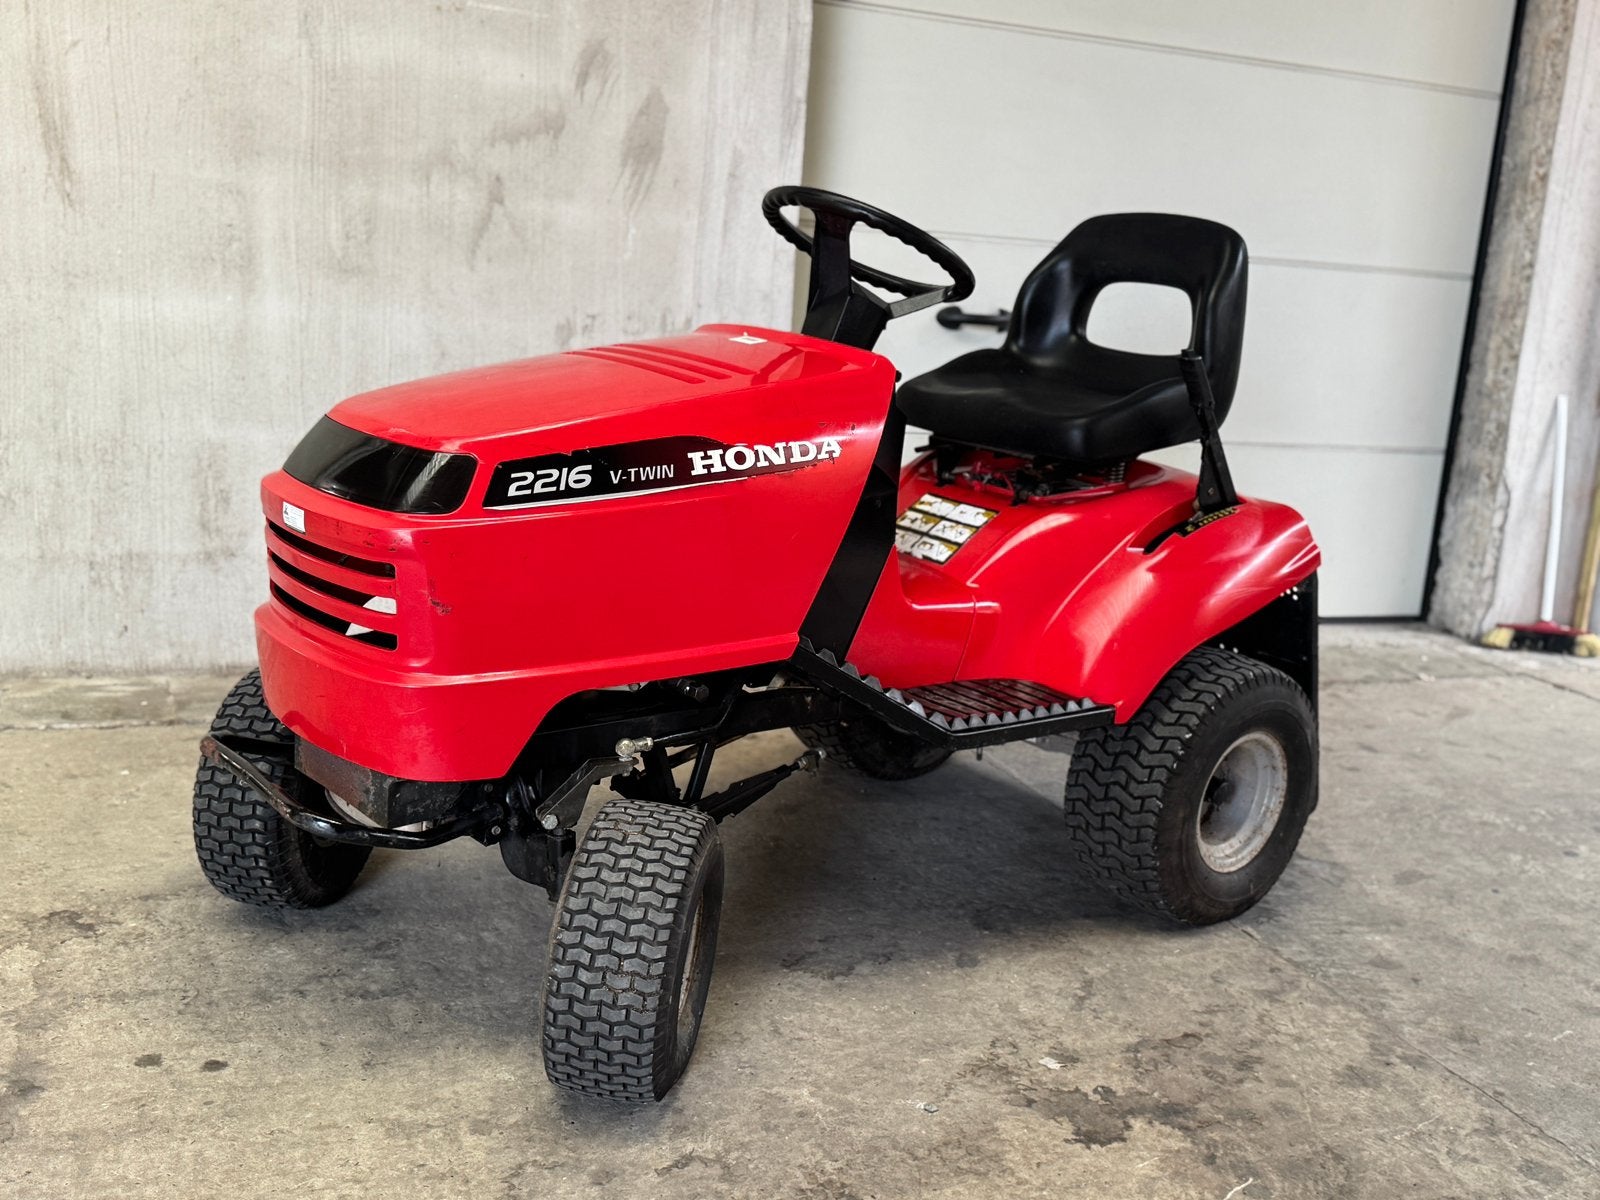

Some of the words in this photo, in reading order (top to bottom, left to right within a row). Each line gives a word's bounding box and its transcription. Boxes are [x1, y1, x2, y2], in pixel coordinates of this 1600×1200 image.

[507, 464, 592, 497] 2216
[610, 464, 674, 484] V-TWIN
[687, 439, 842, 476] HONDA
